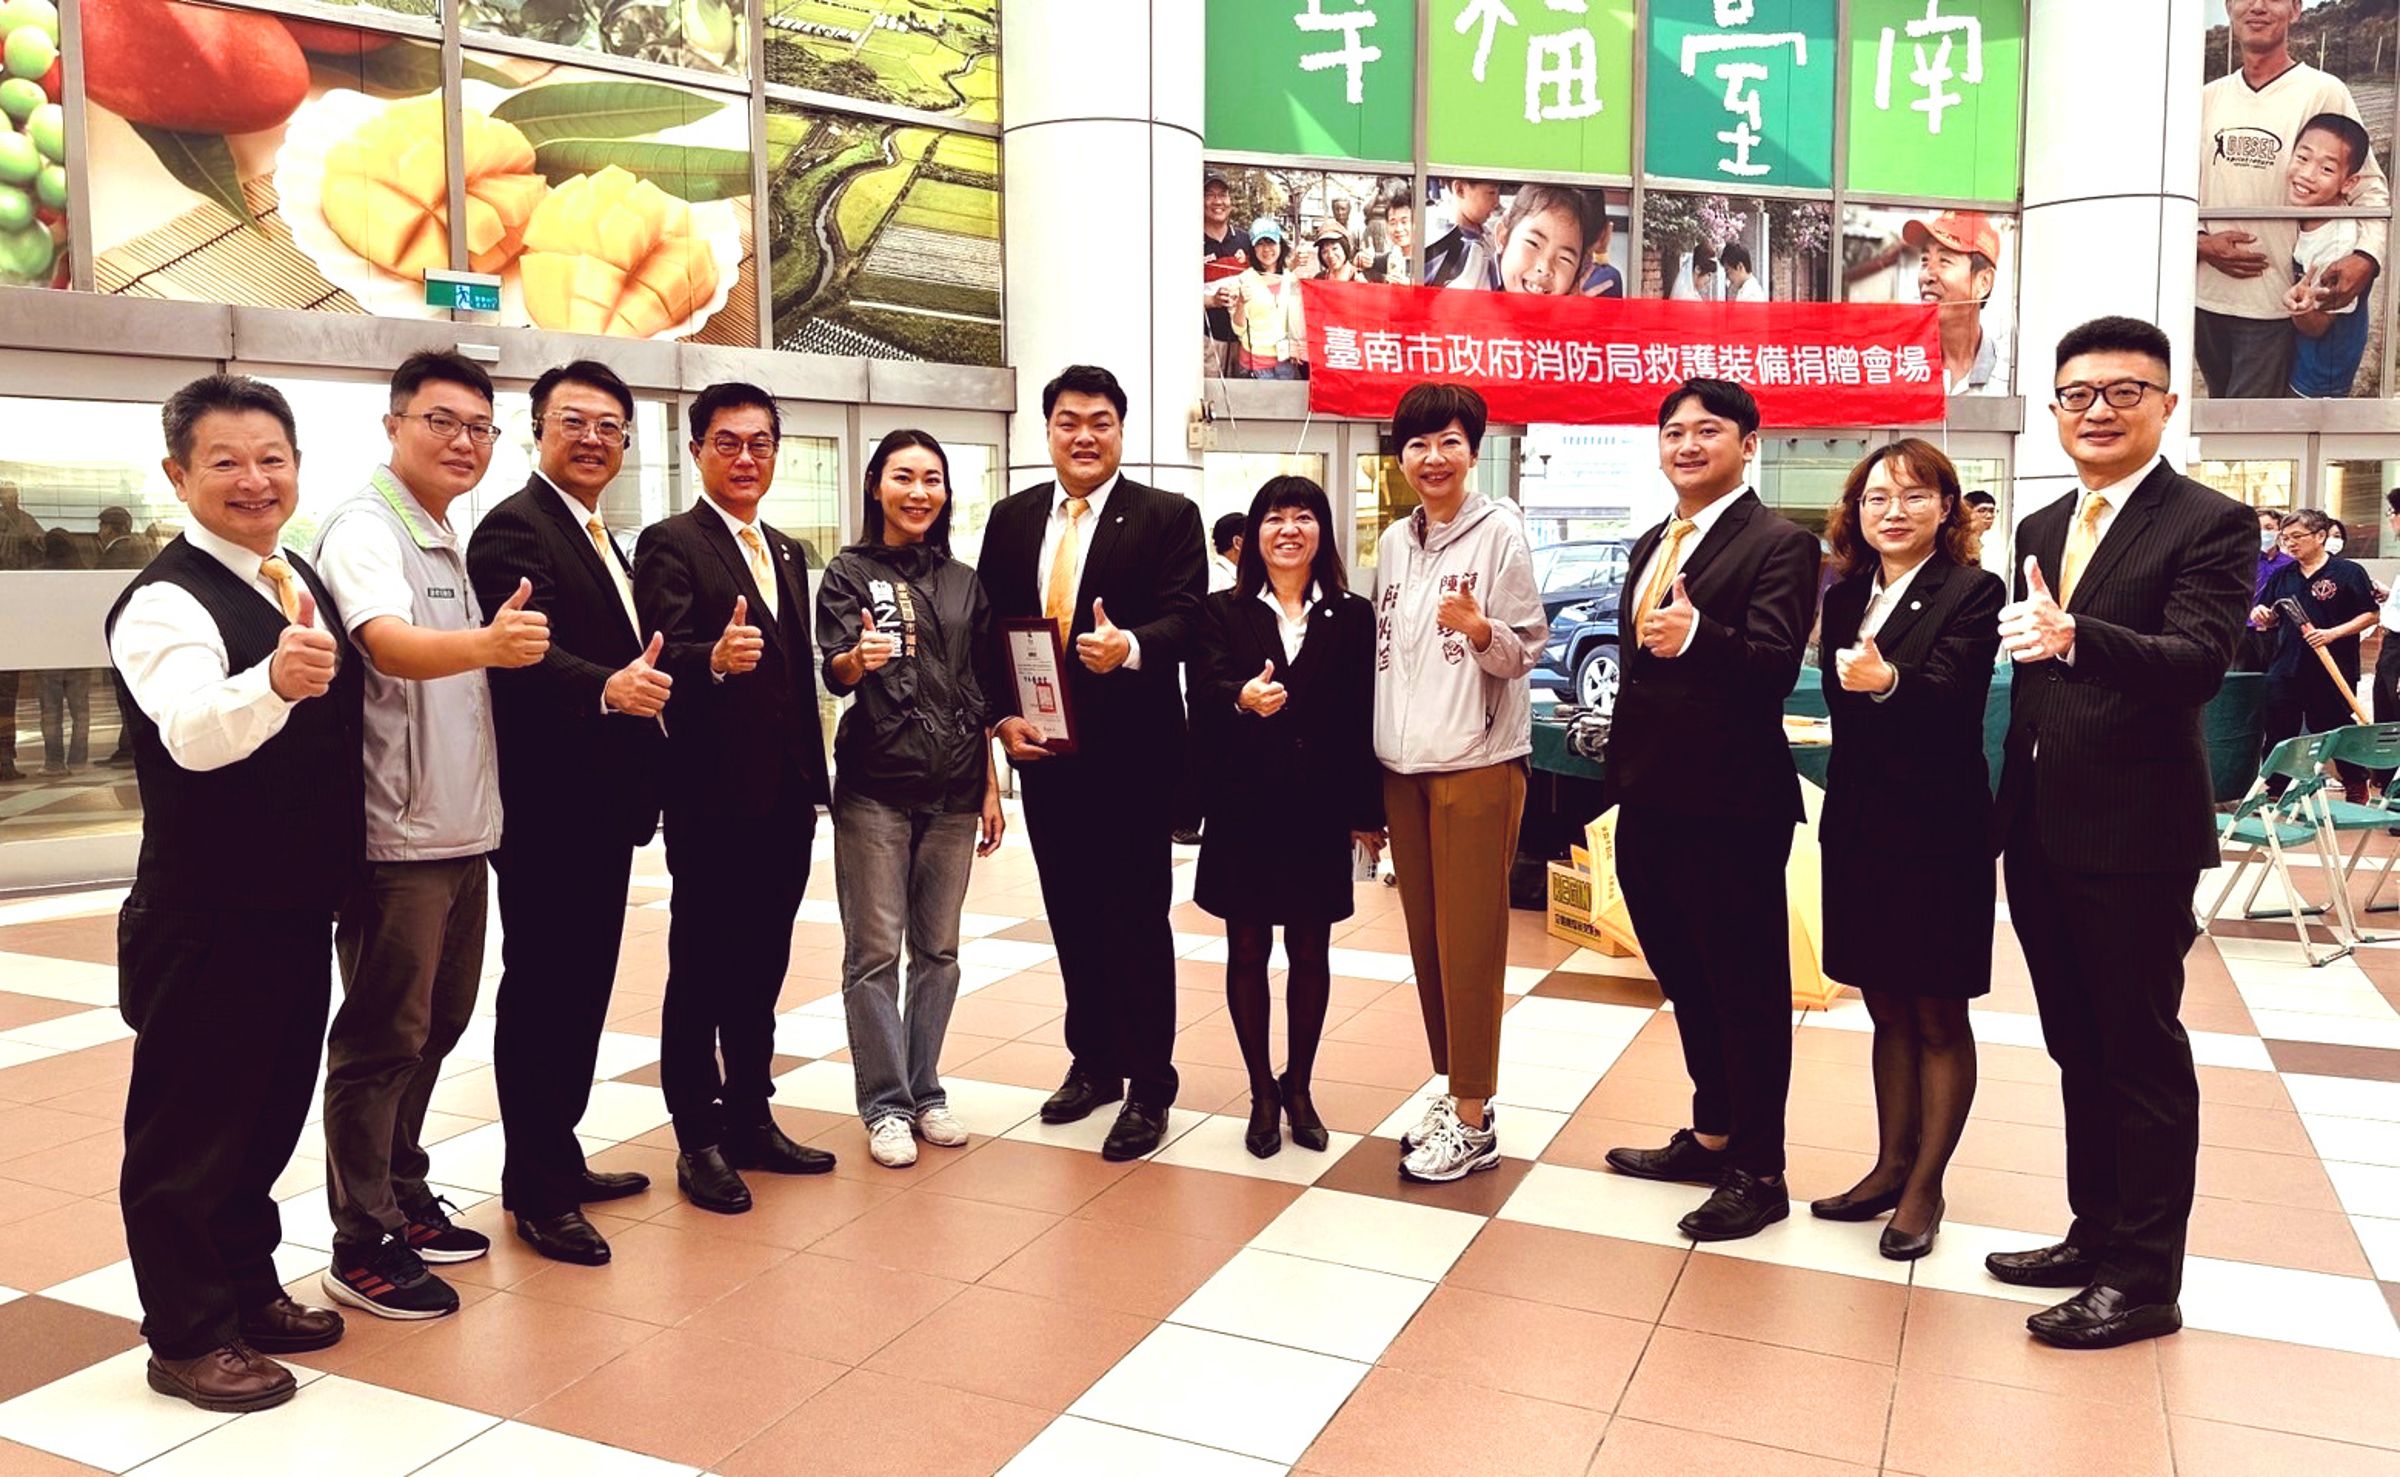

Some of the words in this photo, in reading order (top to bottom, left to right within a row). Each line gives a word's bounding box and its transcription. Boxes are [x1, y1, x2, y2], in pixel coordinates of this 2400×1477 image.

[1323, 326, 1931, 385] 臺南市政府消防局救護裝備捐贈會場
